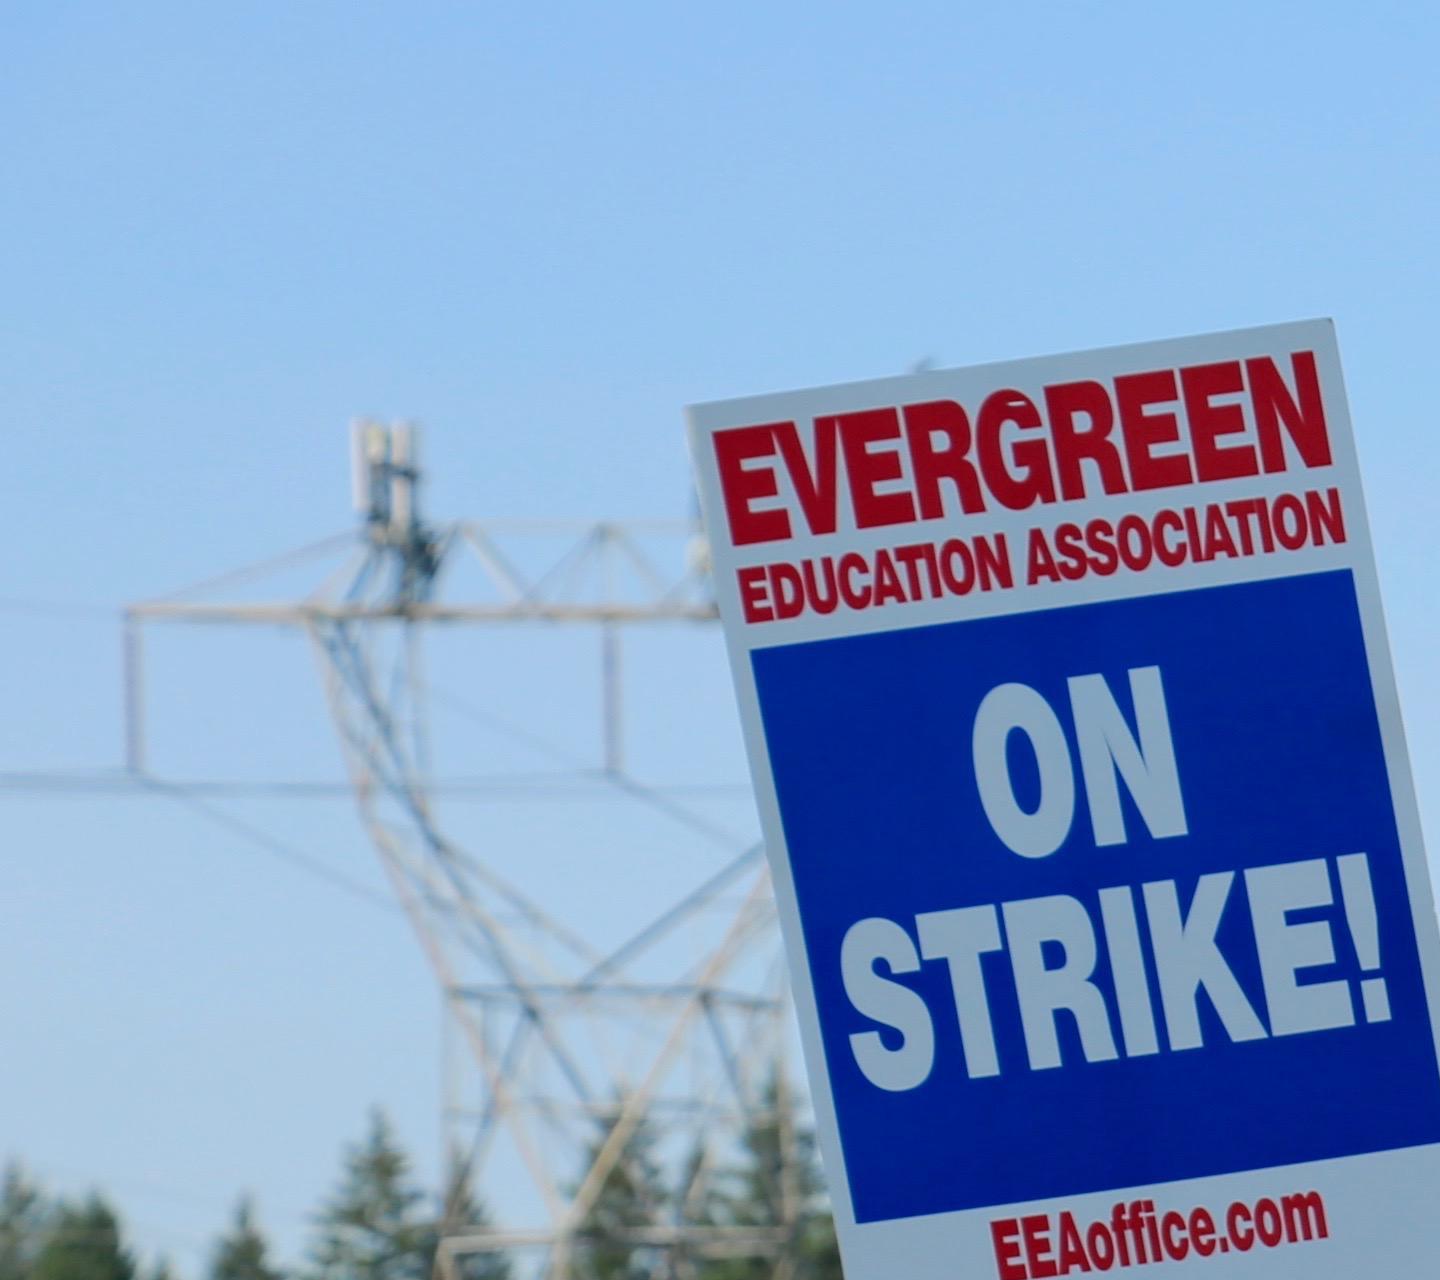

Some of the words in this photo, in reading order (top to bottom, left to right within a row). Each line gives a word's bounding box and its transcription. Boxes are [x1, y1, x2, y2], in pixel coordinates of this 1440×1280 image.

[713, 350, 1333, 546] EVERGREEN
[738, 532, 1014, 625] EDUCATION
[1027, 487, 1347, 585] ASSOCIATION
[971, 664, 1189, 859] ON
[840, 853, 1392, 1092] STRIKE!
